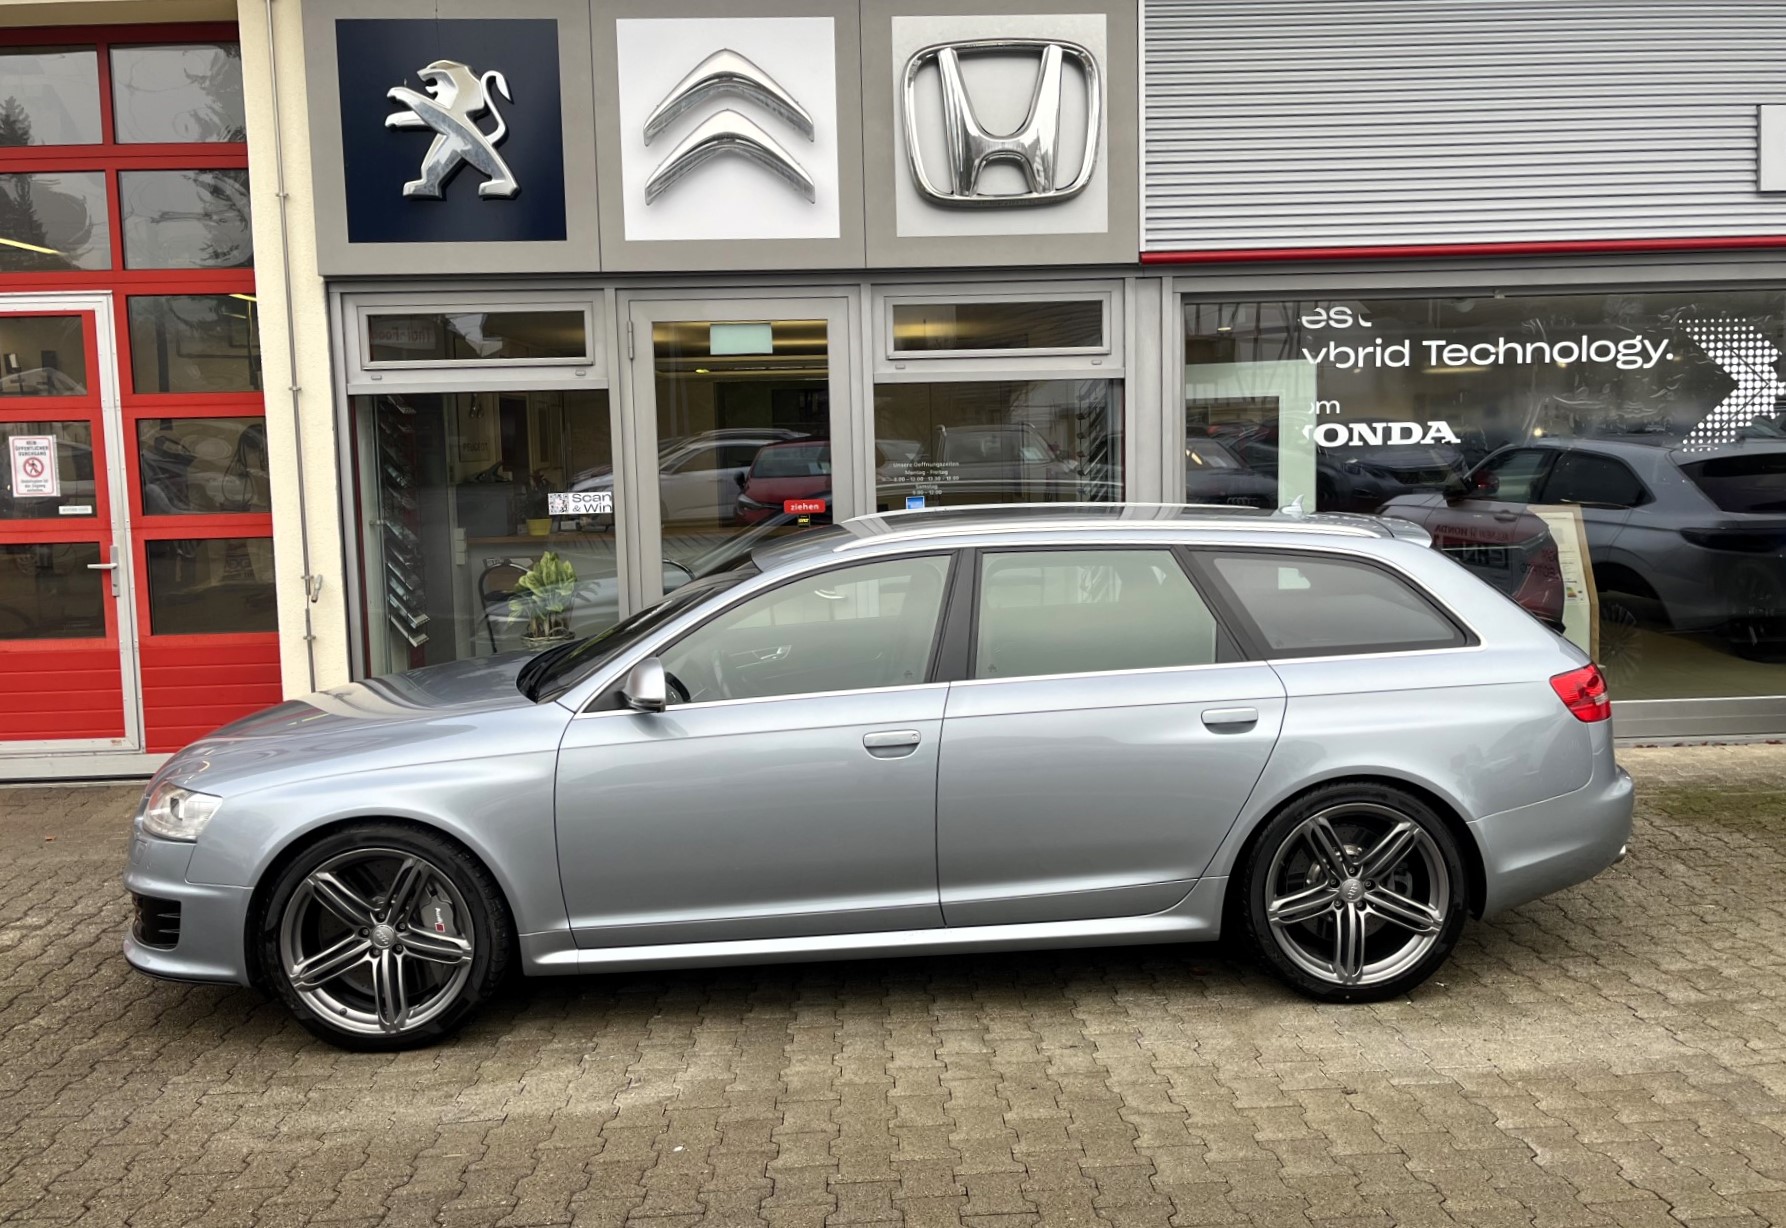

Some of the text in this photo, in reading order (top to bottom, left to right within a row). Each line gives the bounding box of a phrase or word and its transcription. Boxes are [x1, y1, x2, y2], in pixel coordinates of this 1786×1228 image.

[1422, 335, 1674, 370] Technology.
[572, 493, 612, 503] Scan
[572, 502, 613, 513] & Win
[790, 503, 820, 511] ziehen
